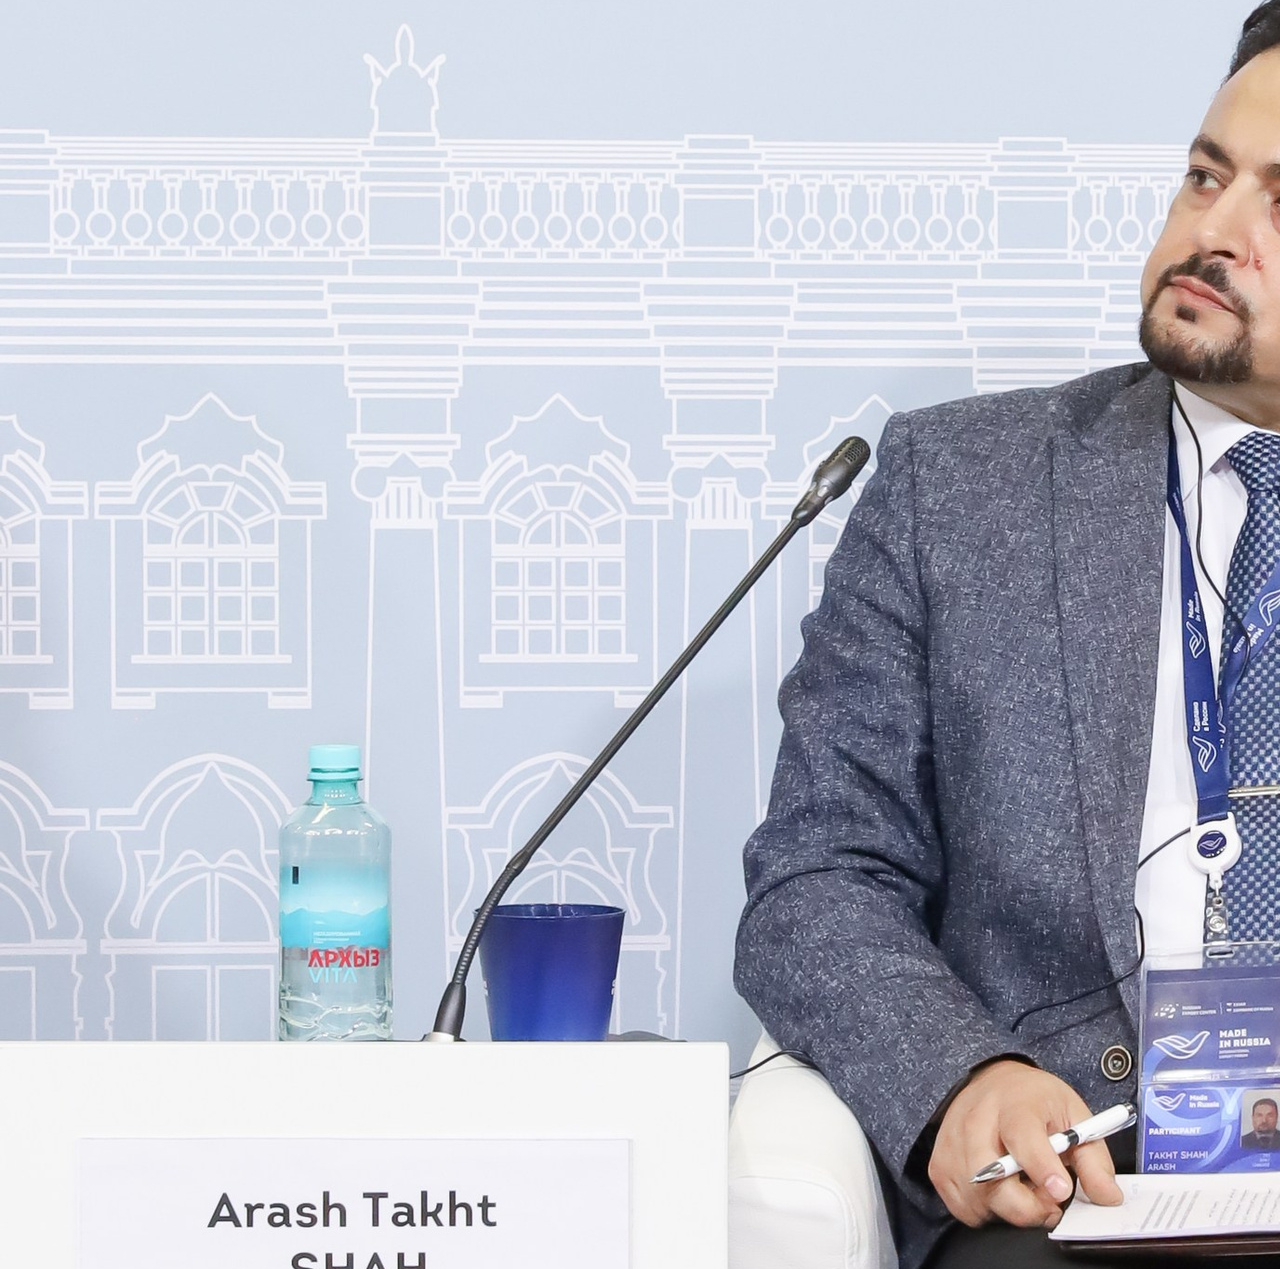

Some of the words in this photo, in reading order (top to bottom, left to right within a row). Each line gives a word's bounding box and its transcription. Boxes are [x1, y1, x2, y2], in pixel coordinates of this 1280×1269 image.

[308, 949, 380, 968] АРХЫЗ
[308, 968, 357, 984] VITA
[1219, 1029, 1247, 1038] MADE
[1219, 1040, 1231, 1048] IN
[1233, 1038, 1271, 1047] RUSSIA
[1149, 1127, 1201, 1135] PARTICIPANT
[1149, 1152, 1178, 1160] TAKHT
[1181, 1151, 1209, 1160] SHAHI
[208, 1191, 346, 1228] Arash
[363, 1191, 497, 1228] Takht
